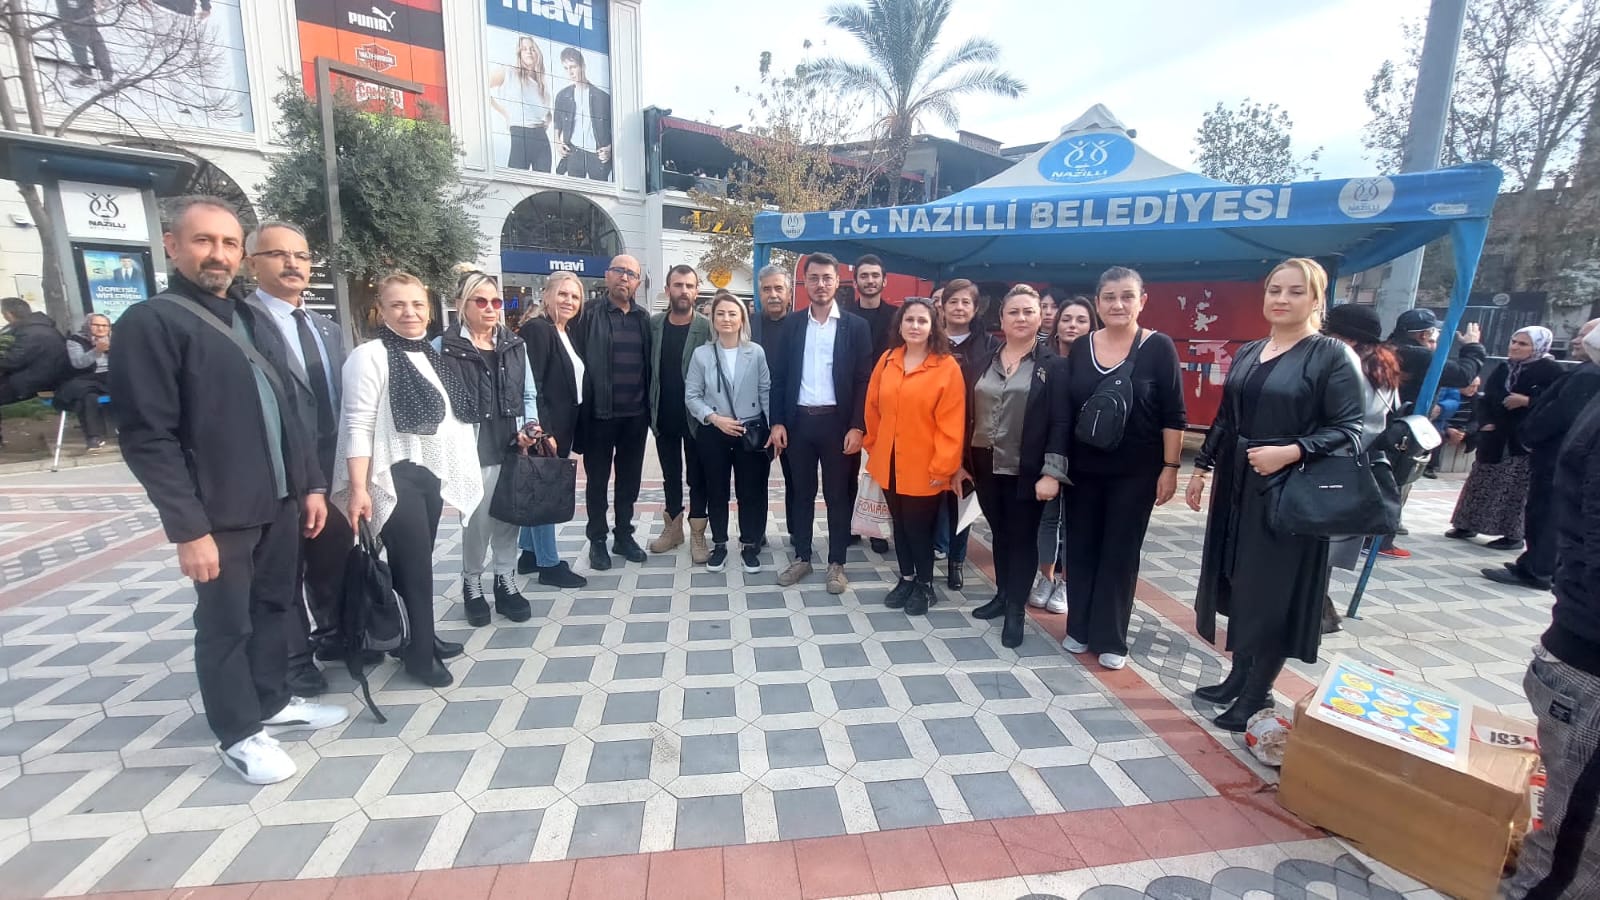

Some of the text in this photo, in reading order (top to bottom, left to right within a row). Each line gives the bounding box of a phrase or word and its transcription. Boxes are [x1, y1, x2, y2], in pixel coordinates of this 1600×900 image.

[348, 11, 390, 32] PUMA
[829, 183, 1292, 235] T.C. NAZİLLİ BELEDİYESİ
[549, 259, 584, 271] mavi
